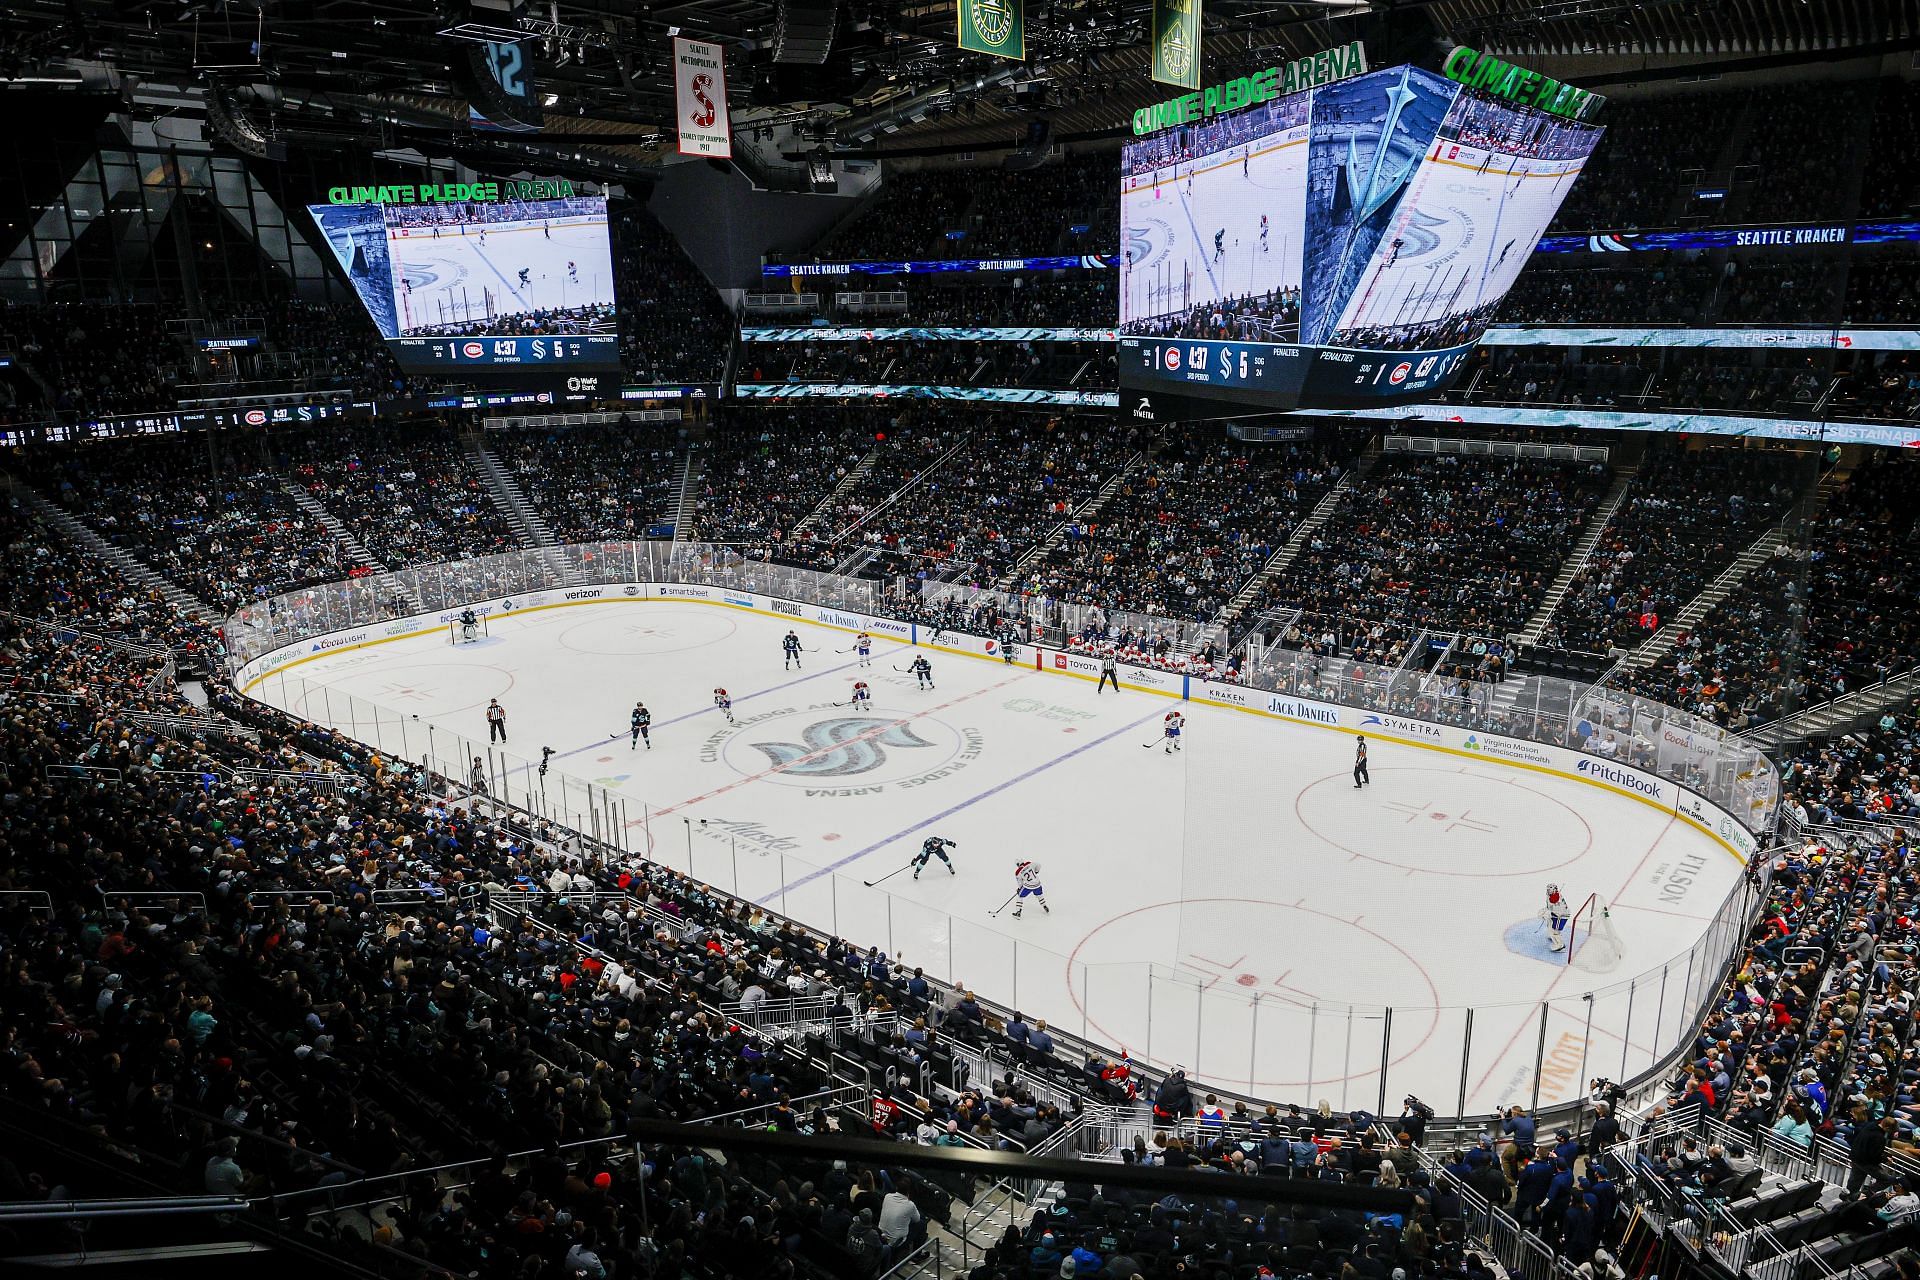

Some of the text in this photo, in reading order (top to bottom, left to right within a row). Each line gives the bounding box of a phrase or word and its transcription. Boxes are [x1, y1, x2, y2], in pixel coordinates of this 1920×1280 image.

[690, 45, 709, 55] SEATTLE
[1133, 41, 1364, 136] CLIMATE PLEDGE ARENA
[1446, 46, 1542, 104] CLIMATE
[1533, 79, 1590, 119] PLEDGE
[680, 132, 698, 141] STANLEY
[706, 134, 728, 144] CHAMPIONS
[1458, 151, 1476, 160] TOYOTA
[328, 180, 575, 205] CLIMATE PLEDGE ARENA
[1448, 206, 1474, 227] CLIMATE
[1736, 228, 1846, 247] SEATTLE KRAKEN
[979, 260, 1024, 270] SEATTLE KRAKEN
[1424, 250, 1460, 270] ARENA
[790, 264, 850, 276] SEATTLE KRAKEN
[814, 330, 841, 339] FRESH,
[1056, 331, 1082, 340] FRESH,
[494, 340, 516, 356] 4:37
[554, 341, 562, 358] 5
[1122, 339, 1140, 348] PENALTIES
[450, 342, 456, 359] 1
[1273, 348, 1300, 358] PENALTIES
[1320, 350, 1355, 363] PENALTIES
[1154, 345, 1160, 370] 1
[1188, 346, 1208, 370] 4:37
[1254, 357, 1264, 366] SOG
[1239, 352, 1248, 378] 5
[1360, 364, 1372, 373] SOG
[1196, 373, 1210, 382] PERIOD
[1256, 368, 1262, 377] 24
[1372, 364, 1387, 385] 1
[580, 377, 598, 385] WaFd
[1354, 376, 1364, 384] 23
[654, 390, 682, 398] PARTNERS
[812, 386, 838, 396] FRESH,
[1055, 393, 1082, 402] FRESH,
[232, 414, 238, 424] 1
[320, 408, 326, 418] 5
[1133, 409, 1155, 420] SYMETRA
[565, 588, 600, 600] verizon
[668, 588, 708, 598] smartsheet
[770, 600, 802, 617] IMPOSSIBLE
[818, 611, 834, 624] JACK
[874, 621, 908, 633] BOEING
[320, 633, 367, 649] Coors LIGHT
[1070, 660, 1098, 672] TOYOTA
[1210, 690, 1245, 702] KRAKEN
[1268, 697, 1338, 724] JACK DANIEL'S
[1384, 718, 1441, 738] SYMETRA
[700, 706, 798, 764] CLIMATE PLEDGE
[1664, 730, 1689, 748] Coors
[1483, 738, 1539, 755] Virginia Mason
[1483, 744, 1551, 765] Franciscan Health
[804, 726, 984, 798] CLIMATE PLEDGE ARENA
[1591, 763, 1662, 798] PitchBook
[1679, 804, 1712, 828] NHLSHOP.com
[706, 818, 801, 850] Alaska
[1024, 868, 1036, 882] 27
[1657, 853, 1711, 905] FILSON
